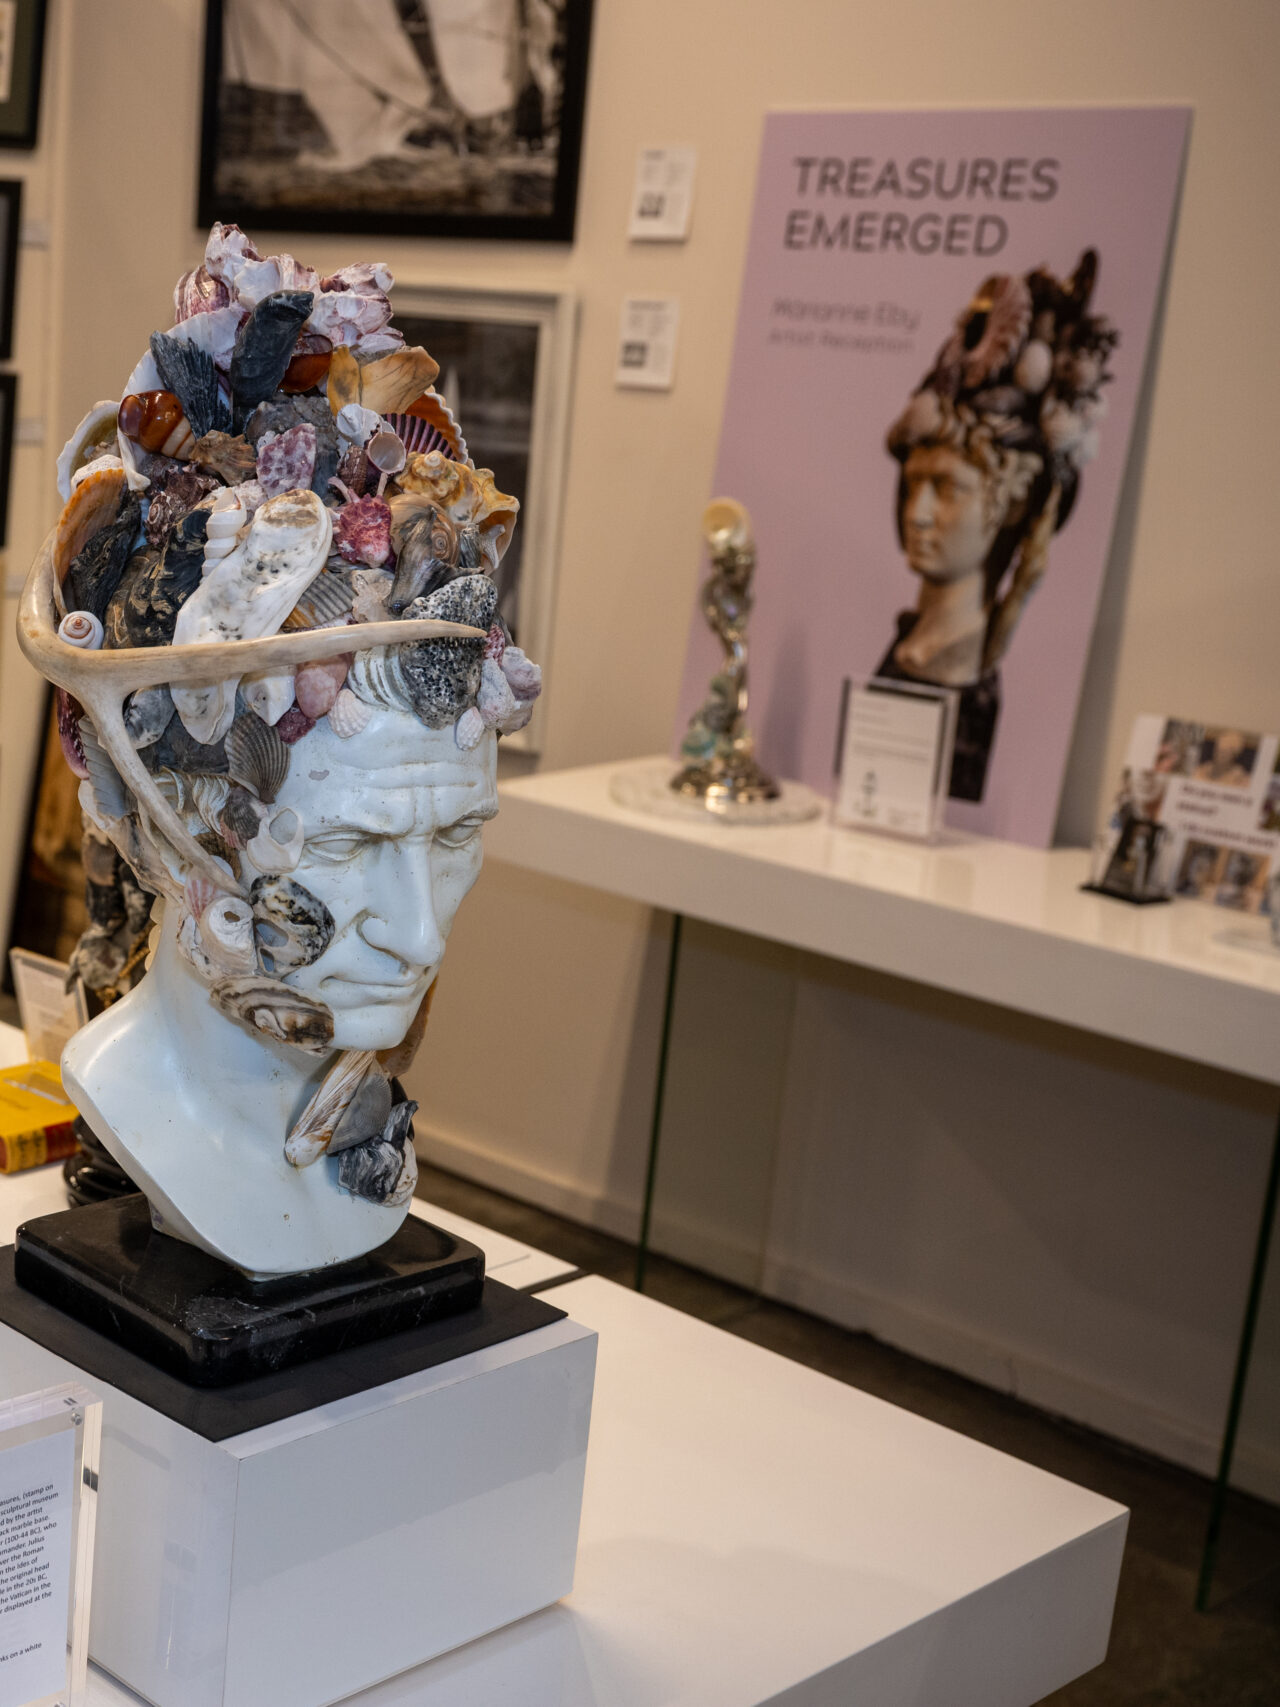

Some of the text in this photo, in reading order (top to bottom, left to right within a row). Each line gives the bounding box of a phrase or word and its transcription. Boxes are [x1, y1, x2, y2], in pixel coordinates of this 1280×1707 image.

[793, 155, 1061, 202] TREASURES
[783, 209, 1009, 257] EMERGED
[0, 1500, 31, 1517] sculptural
[31, 1492, 59, 1506] museum
[14, 1513, 26, 1522] the
[26, 1506, 43, 1518] artist
[10, 1520, 33, 1533] marble
[43, 1521, 58, 1531] who
[27, 1535, 45, 1547] Julius
[10, 1553, 22, 1563] the
[22, 1545, 45, 1558] Roman
[4, 1565, 16, 1574] the
[9, 1567, 34, 1582] original
[33, 1561, 50, 1573] head
[9, 1588, 33, 1601] Vatican
[40, 1581, 52, 1591] the
[13, 1581, 25, 1591] the
[25, 1577, 37, 1586] 20s
[3, 1596, 34, 1613] displayed
[41, 1591, 53, 1600] the
[24, 1642, 43, 1654] white
